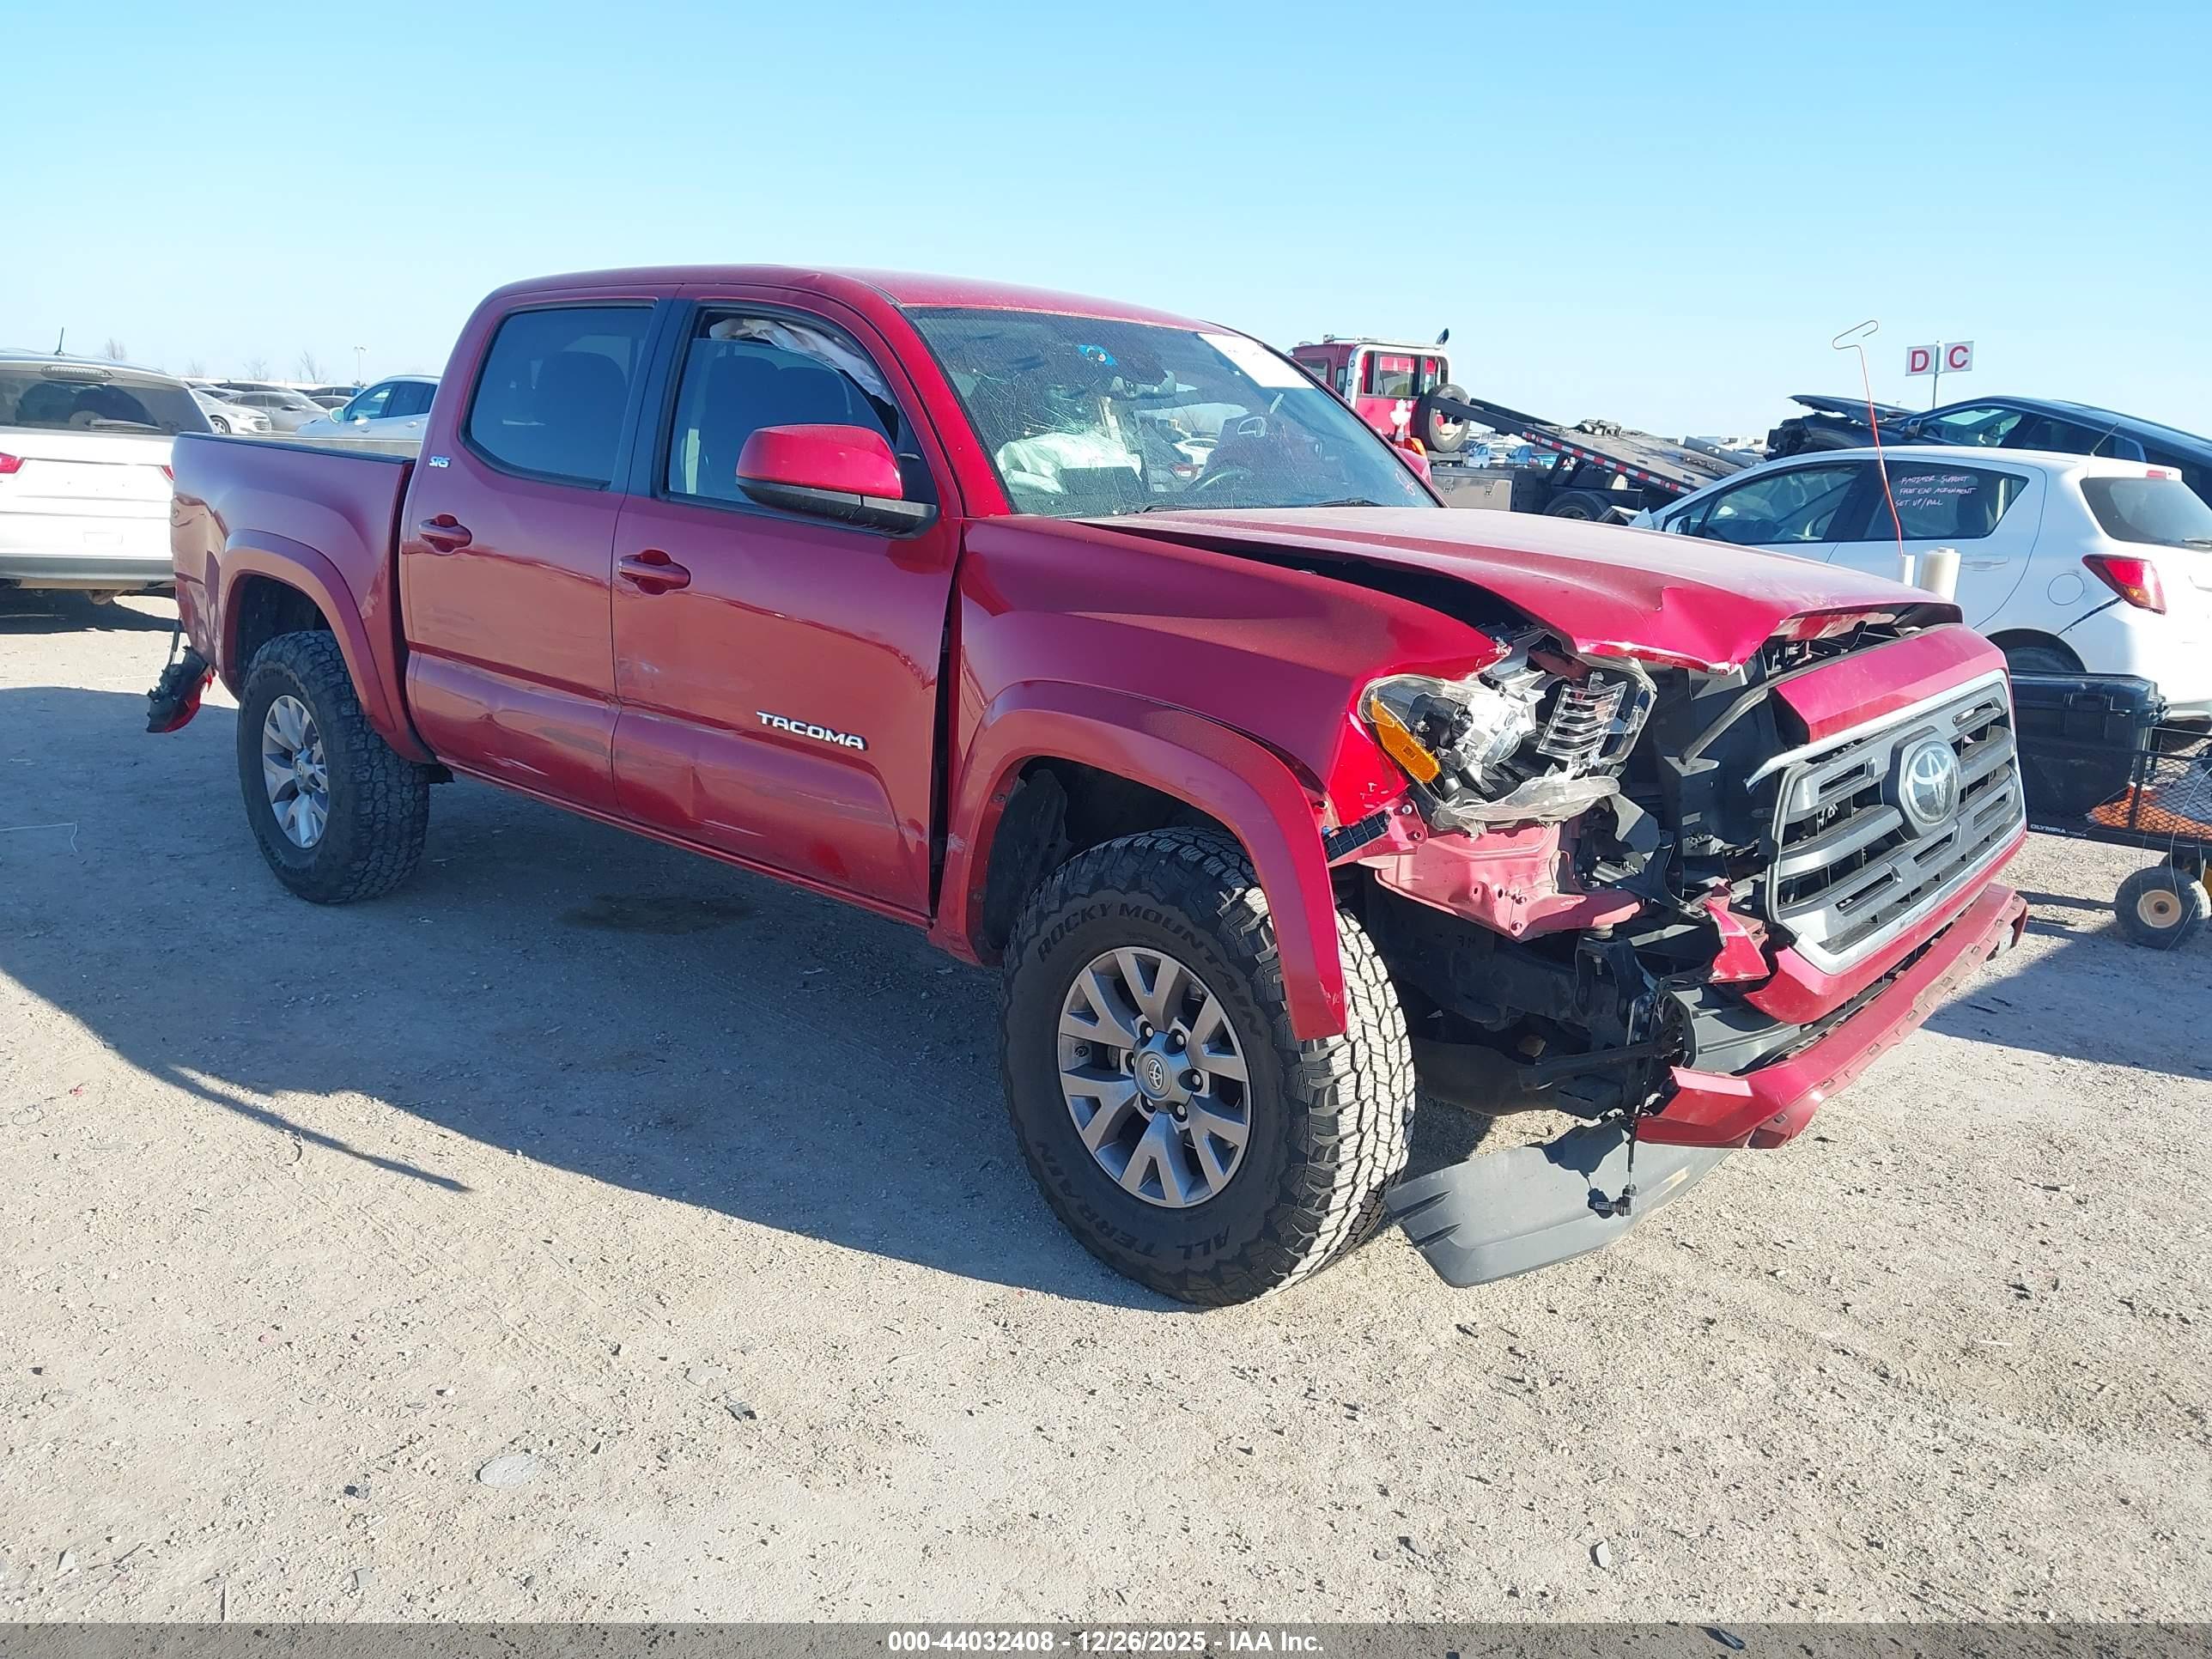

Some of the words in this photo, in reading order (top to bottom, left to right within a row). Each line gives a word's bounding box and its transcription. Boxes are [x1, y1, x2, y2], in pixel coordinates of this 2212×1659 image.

[1911, 349, 1929, 372] D
[1949, 345, 1968, 368] C
[1895, 499, 1911, 507] SET
[756, 711, 868, 750] TACOMA
[2030, 823, 2066, 834] OLYMPIA
[1037, 902, 1115, 963] ROCKY
[1119, 902, 1262, 1041] MOUNTAIN
[1036, 1141, 1160, 1259] TERRAIN
[1176, 1224, 1231, 1261] ALL
